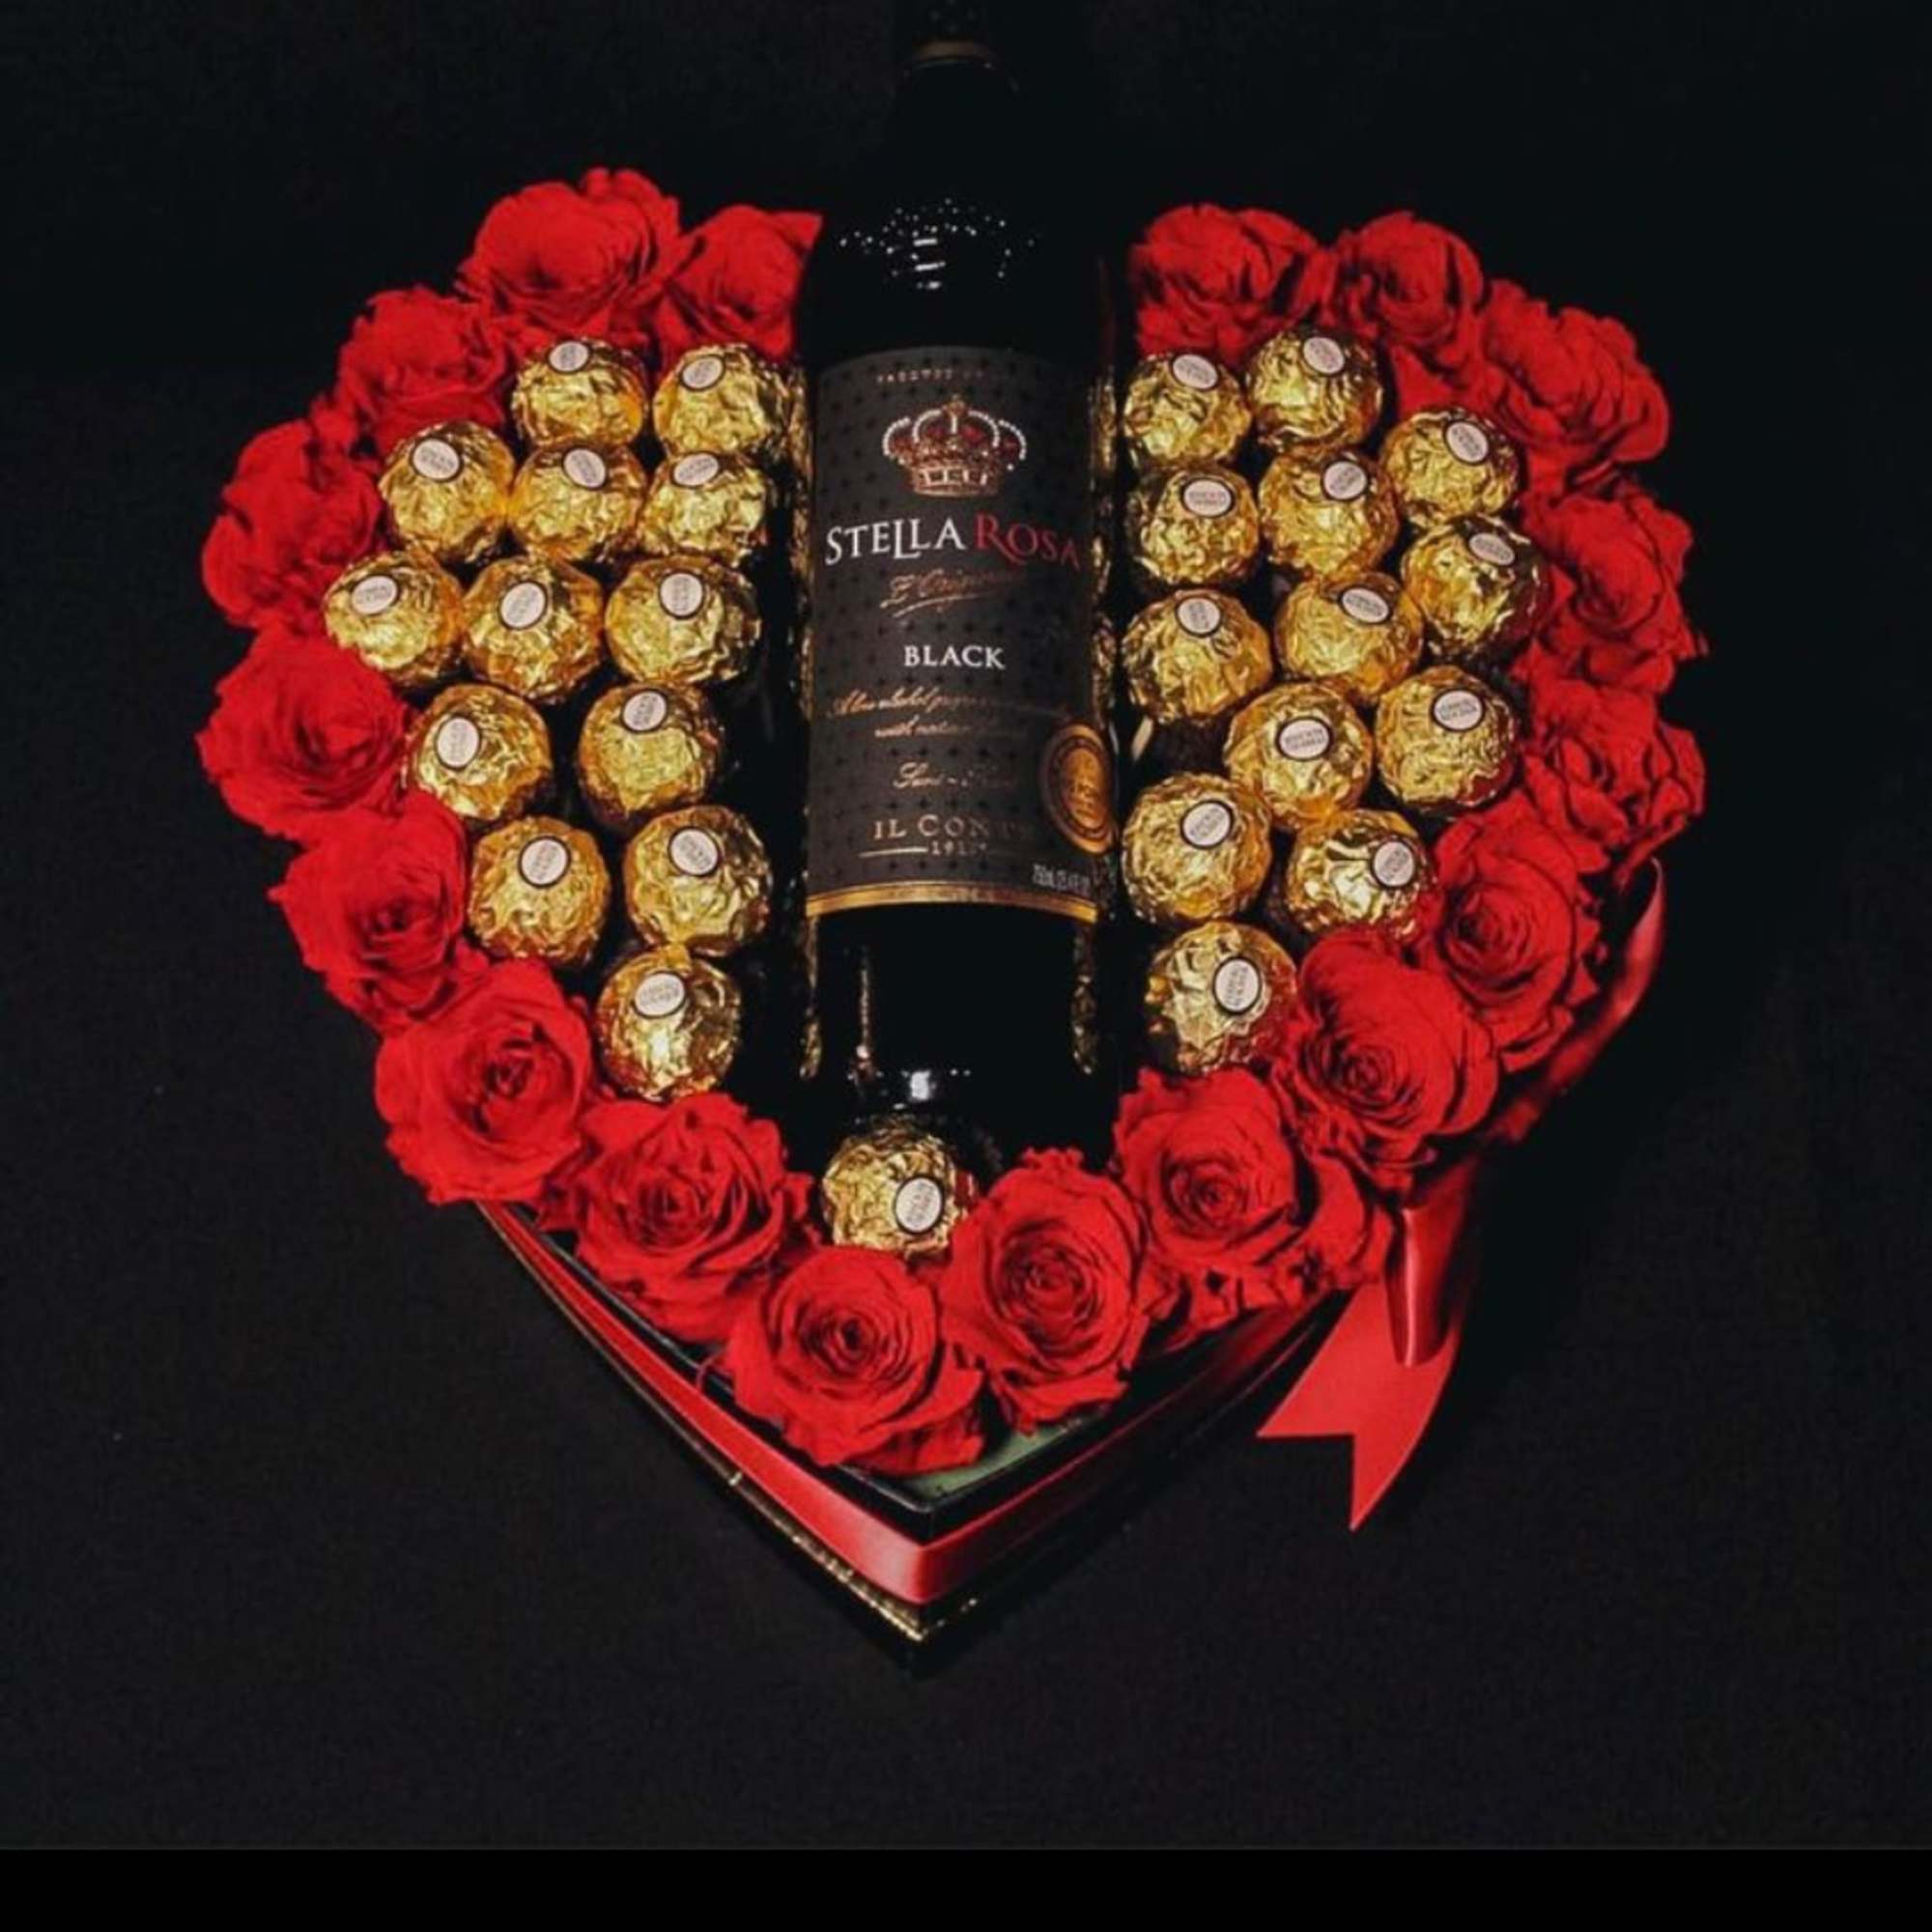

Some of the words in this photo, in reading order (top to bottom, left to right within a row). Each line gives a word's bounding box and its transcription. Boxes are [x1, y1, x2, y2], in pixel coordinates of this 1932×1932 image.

[825, 516, 966, 565] STELLA
[974, 511, 1080, 572] ROSA
[903, 644, 1006, 669] BLACK
